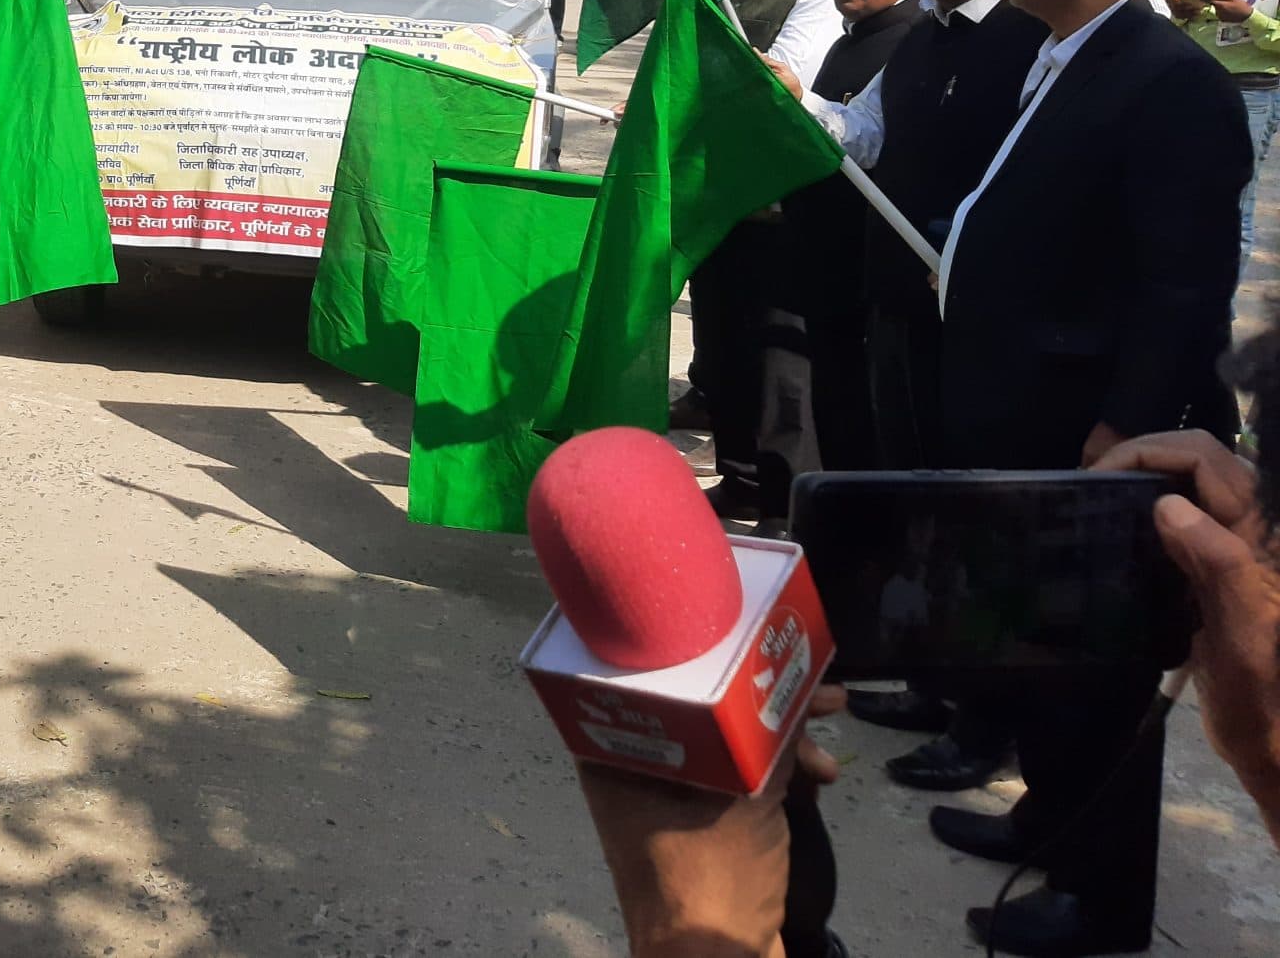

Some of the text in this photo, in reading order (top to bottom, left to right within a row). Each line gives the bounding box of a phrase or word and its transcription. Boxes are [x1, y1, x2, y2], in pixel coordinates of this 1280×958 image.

[232, 40, 297, 64] लोक
[161, 68, 175, 76] U/S
[95, 141, 139, 154] यायाधीश
[176, 142, 309, 162] जिलाधिकारी सह उपाध्यक्ष,
[97, 158, 122, 169] सचिव
[179, 159, 305, 178] जिला विधिक सेवा प्राधिकार,
[225, 176, 256, 190] पूर्णियाँ
[103, 193, 147, 209] नकारी
[151, 194, 169, 209] के
[172, 194, 201, 210] लिए
[203, 199, 260, 213] व्यवहार
[137, 214, 168, 229] सेवा
[171, 214, 236, 234] प्राधिकार,
[240, 218, 293, 237] पूर्णियाँ
[294, 223, 313, 237] के
